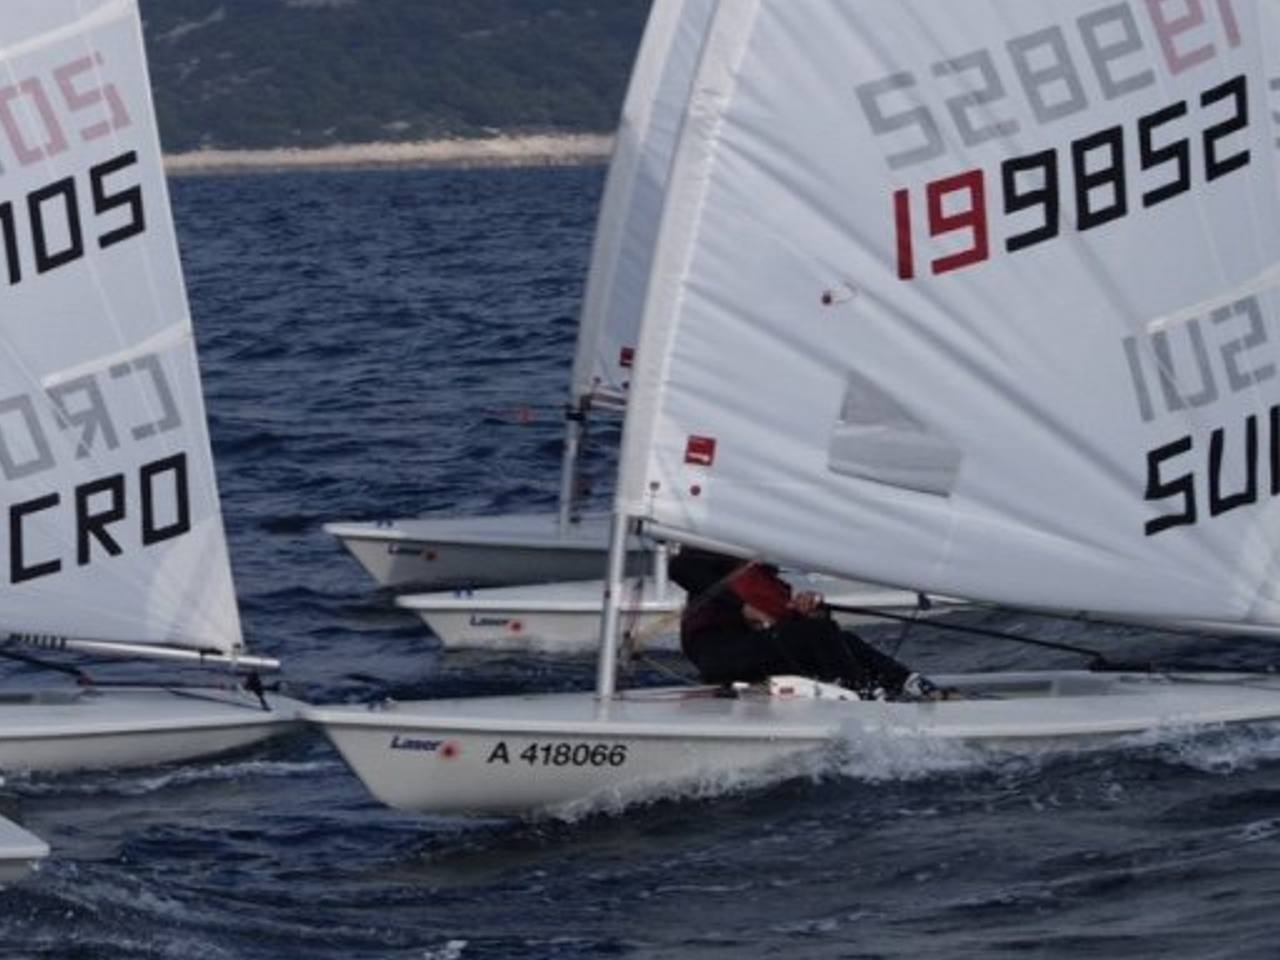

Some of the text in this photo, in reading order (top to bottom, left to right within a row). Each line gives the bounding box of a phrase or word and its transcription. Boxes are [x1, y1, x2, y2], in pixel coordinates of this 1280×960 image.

[894, 74, 1250, 280] 199852
[9, 452, 191, 584] CRO
[486, 742, 627, 766] A 418066
